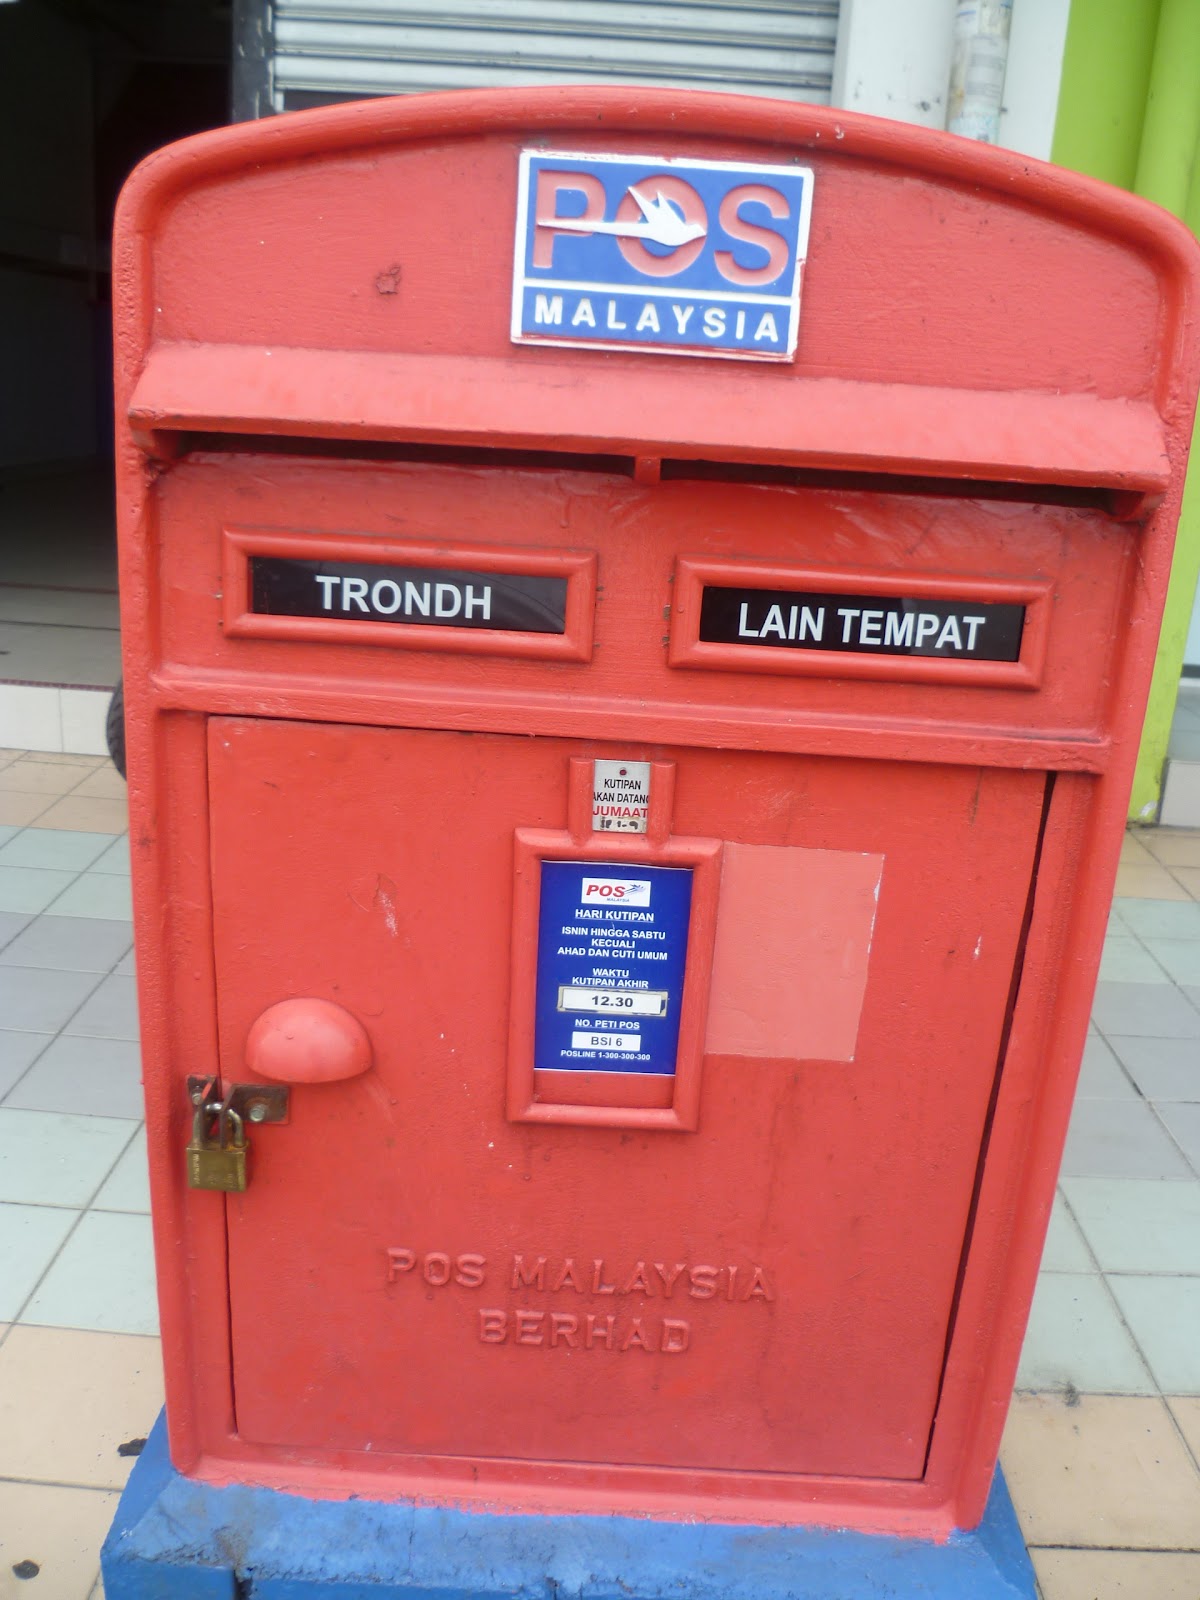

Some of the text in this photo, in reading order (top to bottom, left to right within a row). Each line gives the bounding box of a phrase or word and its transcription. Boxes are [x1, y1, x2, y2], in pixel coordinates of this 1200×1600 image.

[532, 169, 791, 287] POS
[534, 294, 780, 343] MALAYSIA
[315, 574, 492, 621] TRONDH
[737, 602, 986, 650] LAIN TEMPAT
[604, 778, 642, 790] KUTIPAN
[593, 805, 648, 818] JUMAAT
[586, 884, 626, 898] POS
[575, 908, 655, 922] HARI KUTIPAN
[561, 926, 666, 940] ISNIN HINGGA SABTU
[591, 938, 636, 949] KECUALI
[557, 946, 668, 961] AHAD DAN CUTI UMUM
[592, 968, 630, 978] WAKTU
[572, 977, 649, 989] KUTIPAN AKHIR
[591, 995, 634, 1008] 12.30
[574, 1019, 640, 1030] NO. PETI POS
[590, 1036, 623, 1047] BSI 6
[560, 1050, 651, 1061] POSLINE 1-300-300-300
[385, 1247, 777, 1302] POS MALAYSIA
[478, 1308, 693, 1355] BERHAD
